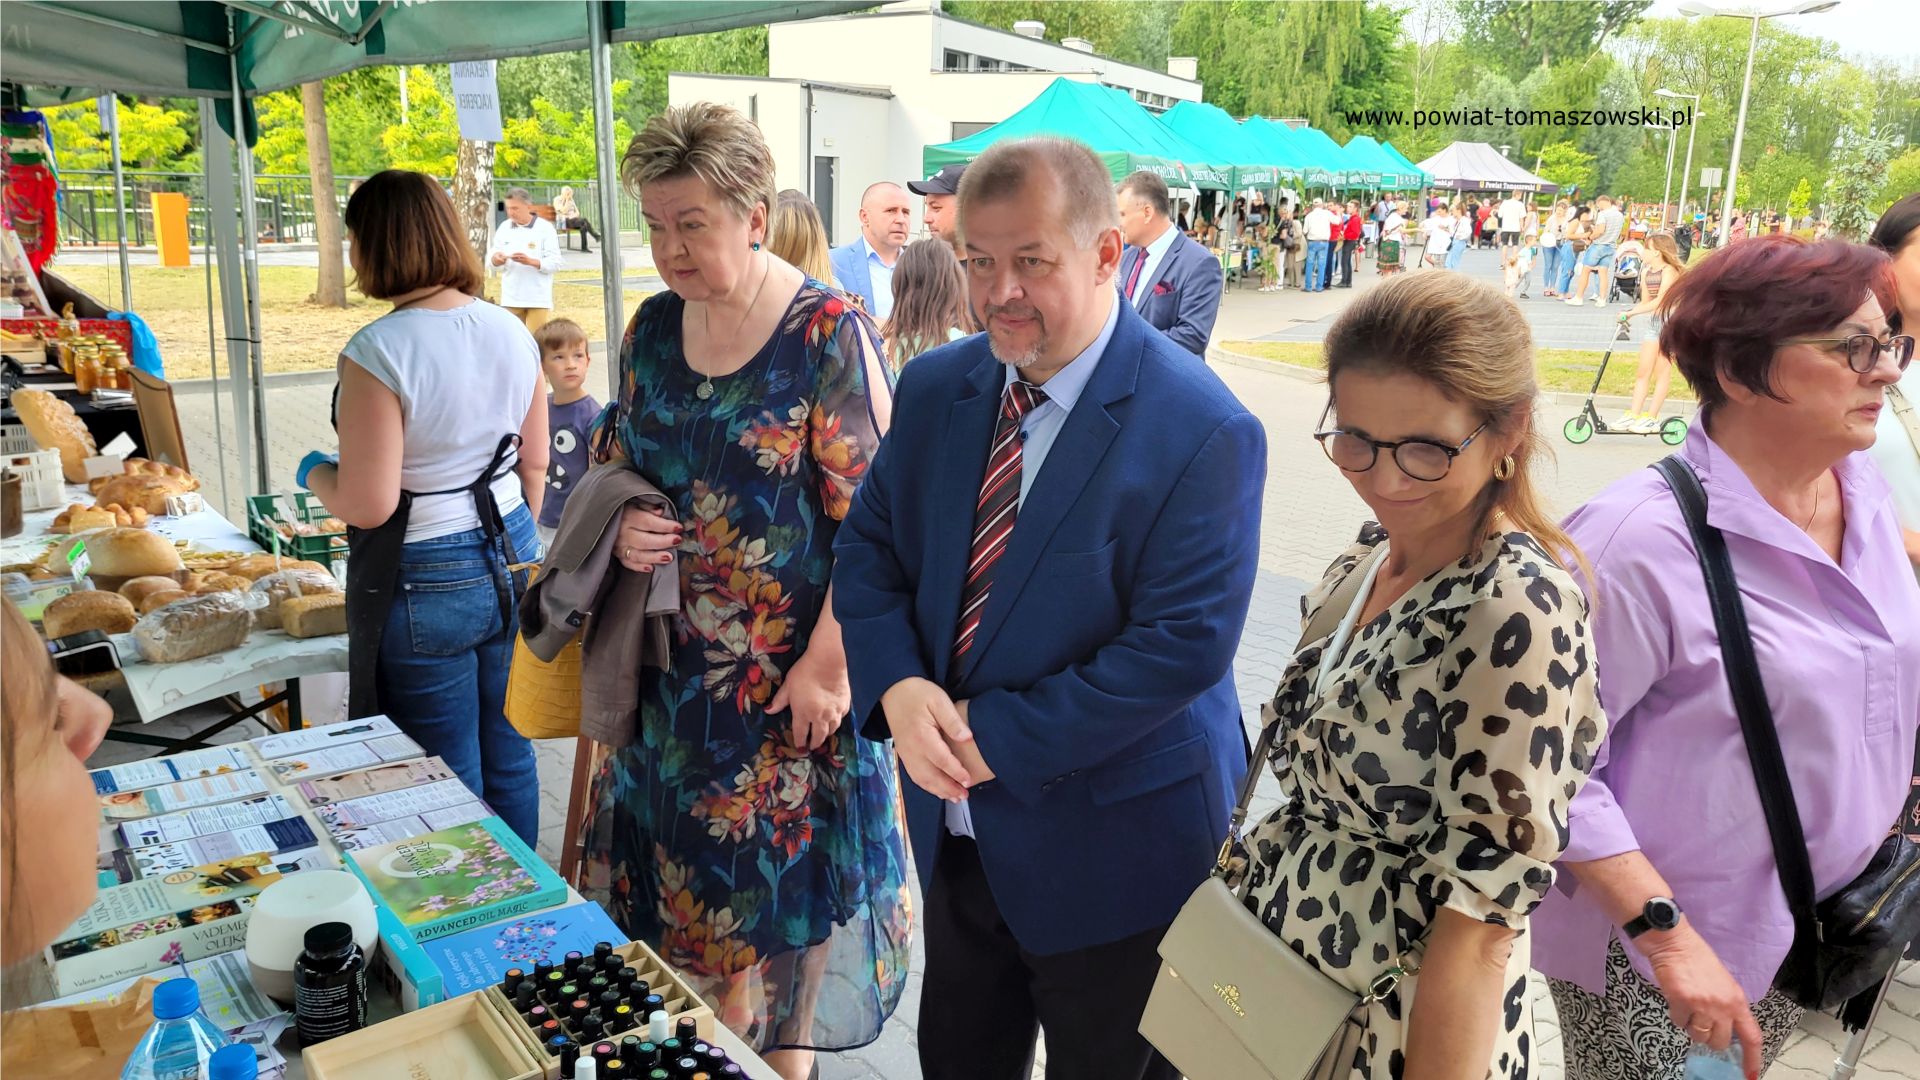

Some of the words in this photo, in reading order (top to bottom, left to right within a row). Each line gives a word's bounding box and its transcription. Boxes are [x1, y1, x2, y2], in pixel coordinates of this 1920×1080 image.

[396, 844, 434, 879] ADVANCED
[193, 918, 249, 941] VADEMEC
[415, 915, 477, 940] ADVANCED
[478, 911, 496, 922] OIL
[497, 901, 528, 917] MAGIC
[206, 931, 247, 950] OLEJK
[98, 972, 114, 982] Ann
[1213, 982, 1245, 1017] WITTCHEN
